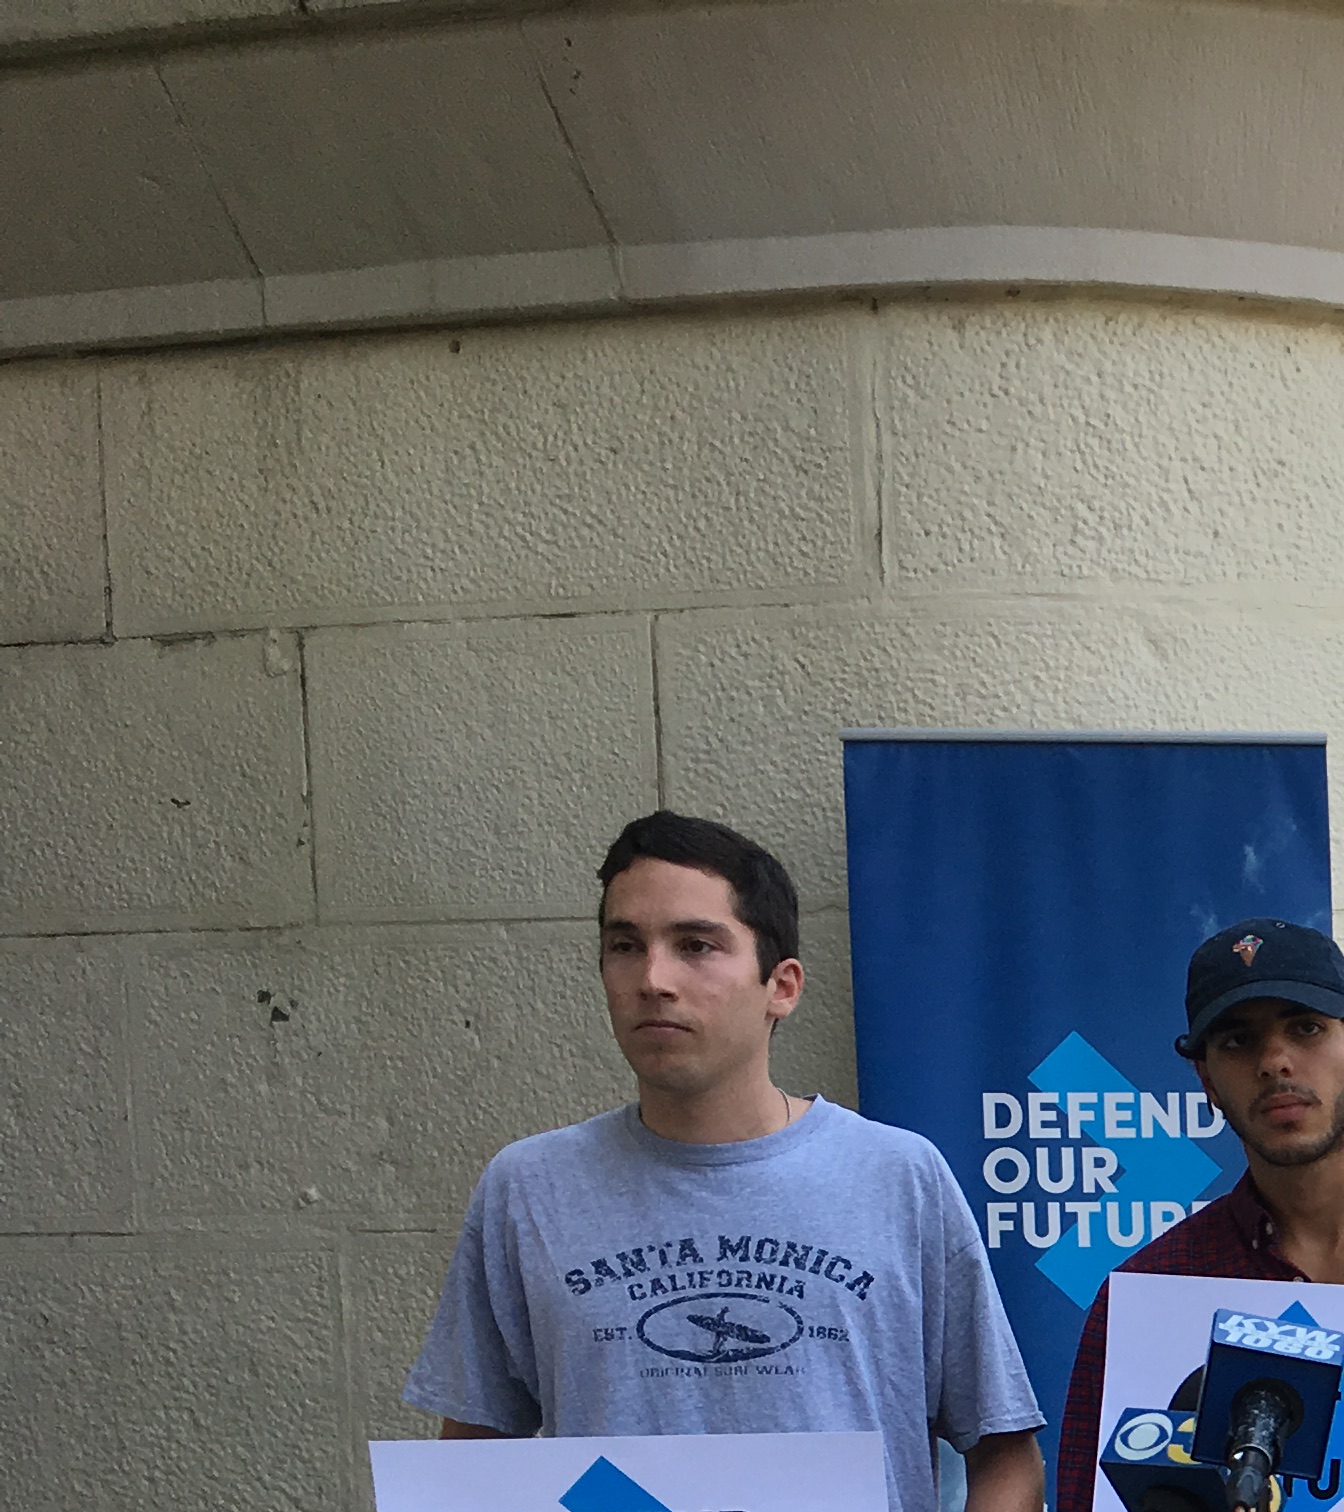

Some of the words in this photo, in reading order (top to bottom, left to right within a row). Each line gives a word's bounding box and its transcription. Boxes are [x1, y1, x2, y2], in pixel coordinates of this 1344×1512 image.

[982, 1091, 1226, 1140] DEFEND
[983, 1147, 1120, 1194] OUR
[986, 1200, 1217, 1248] FUTUR
[563, 1237, 706, 1298] SANTA
[717, 1233, 877, 1302] MONICA
[627, 1268, 807, 1302] CALIFORNIA
